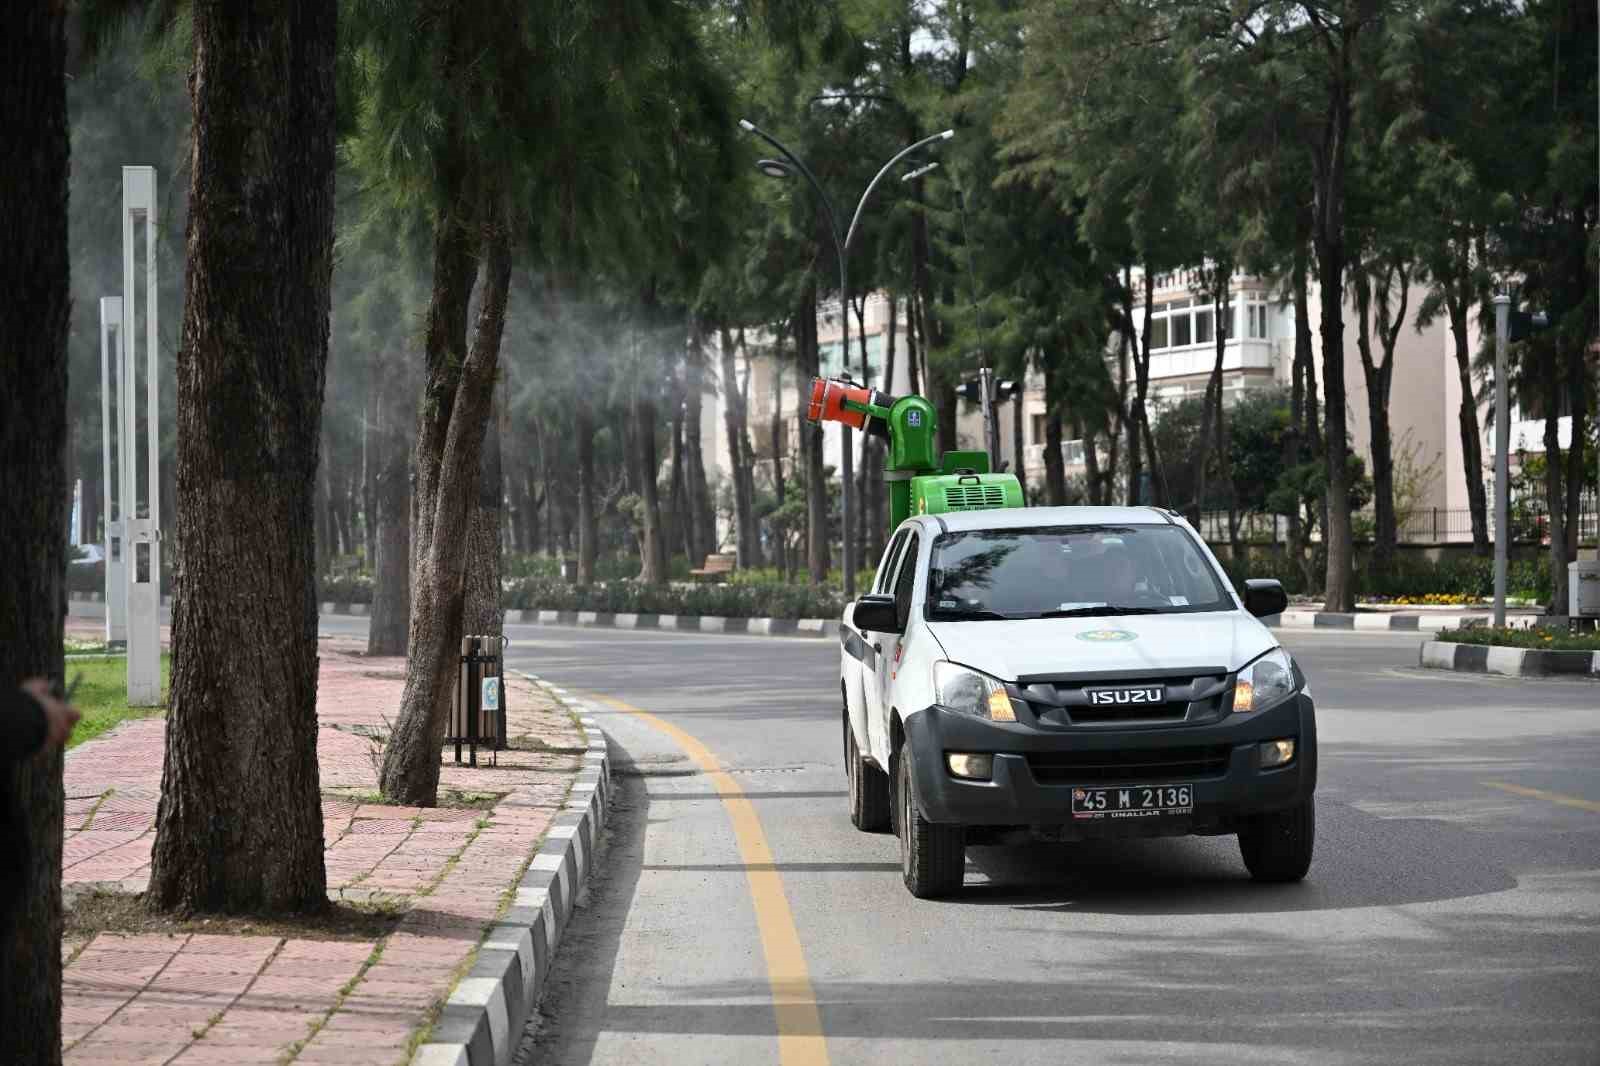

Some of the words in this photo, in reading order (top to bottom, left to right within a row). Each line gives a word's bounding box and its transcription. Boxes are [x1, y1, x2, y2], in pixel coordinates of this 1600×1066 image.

[1091, 689, 1161, 704] ISUZU
[1083, 791, 1107, 809] 45
[1119, 790, 1130, 808] M
[1142, 788, 1190, 807] 2136
